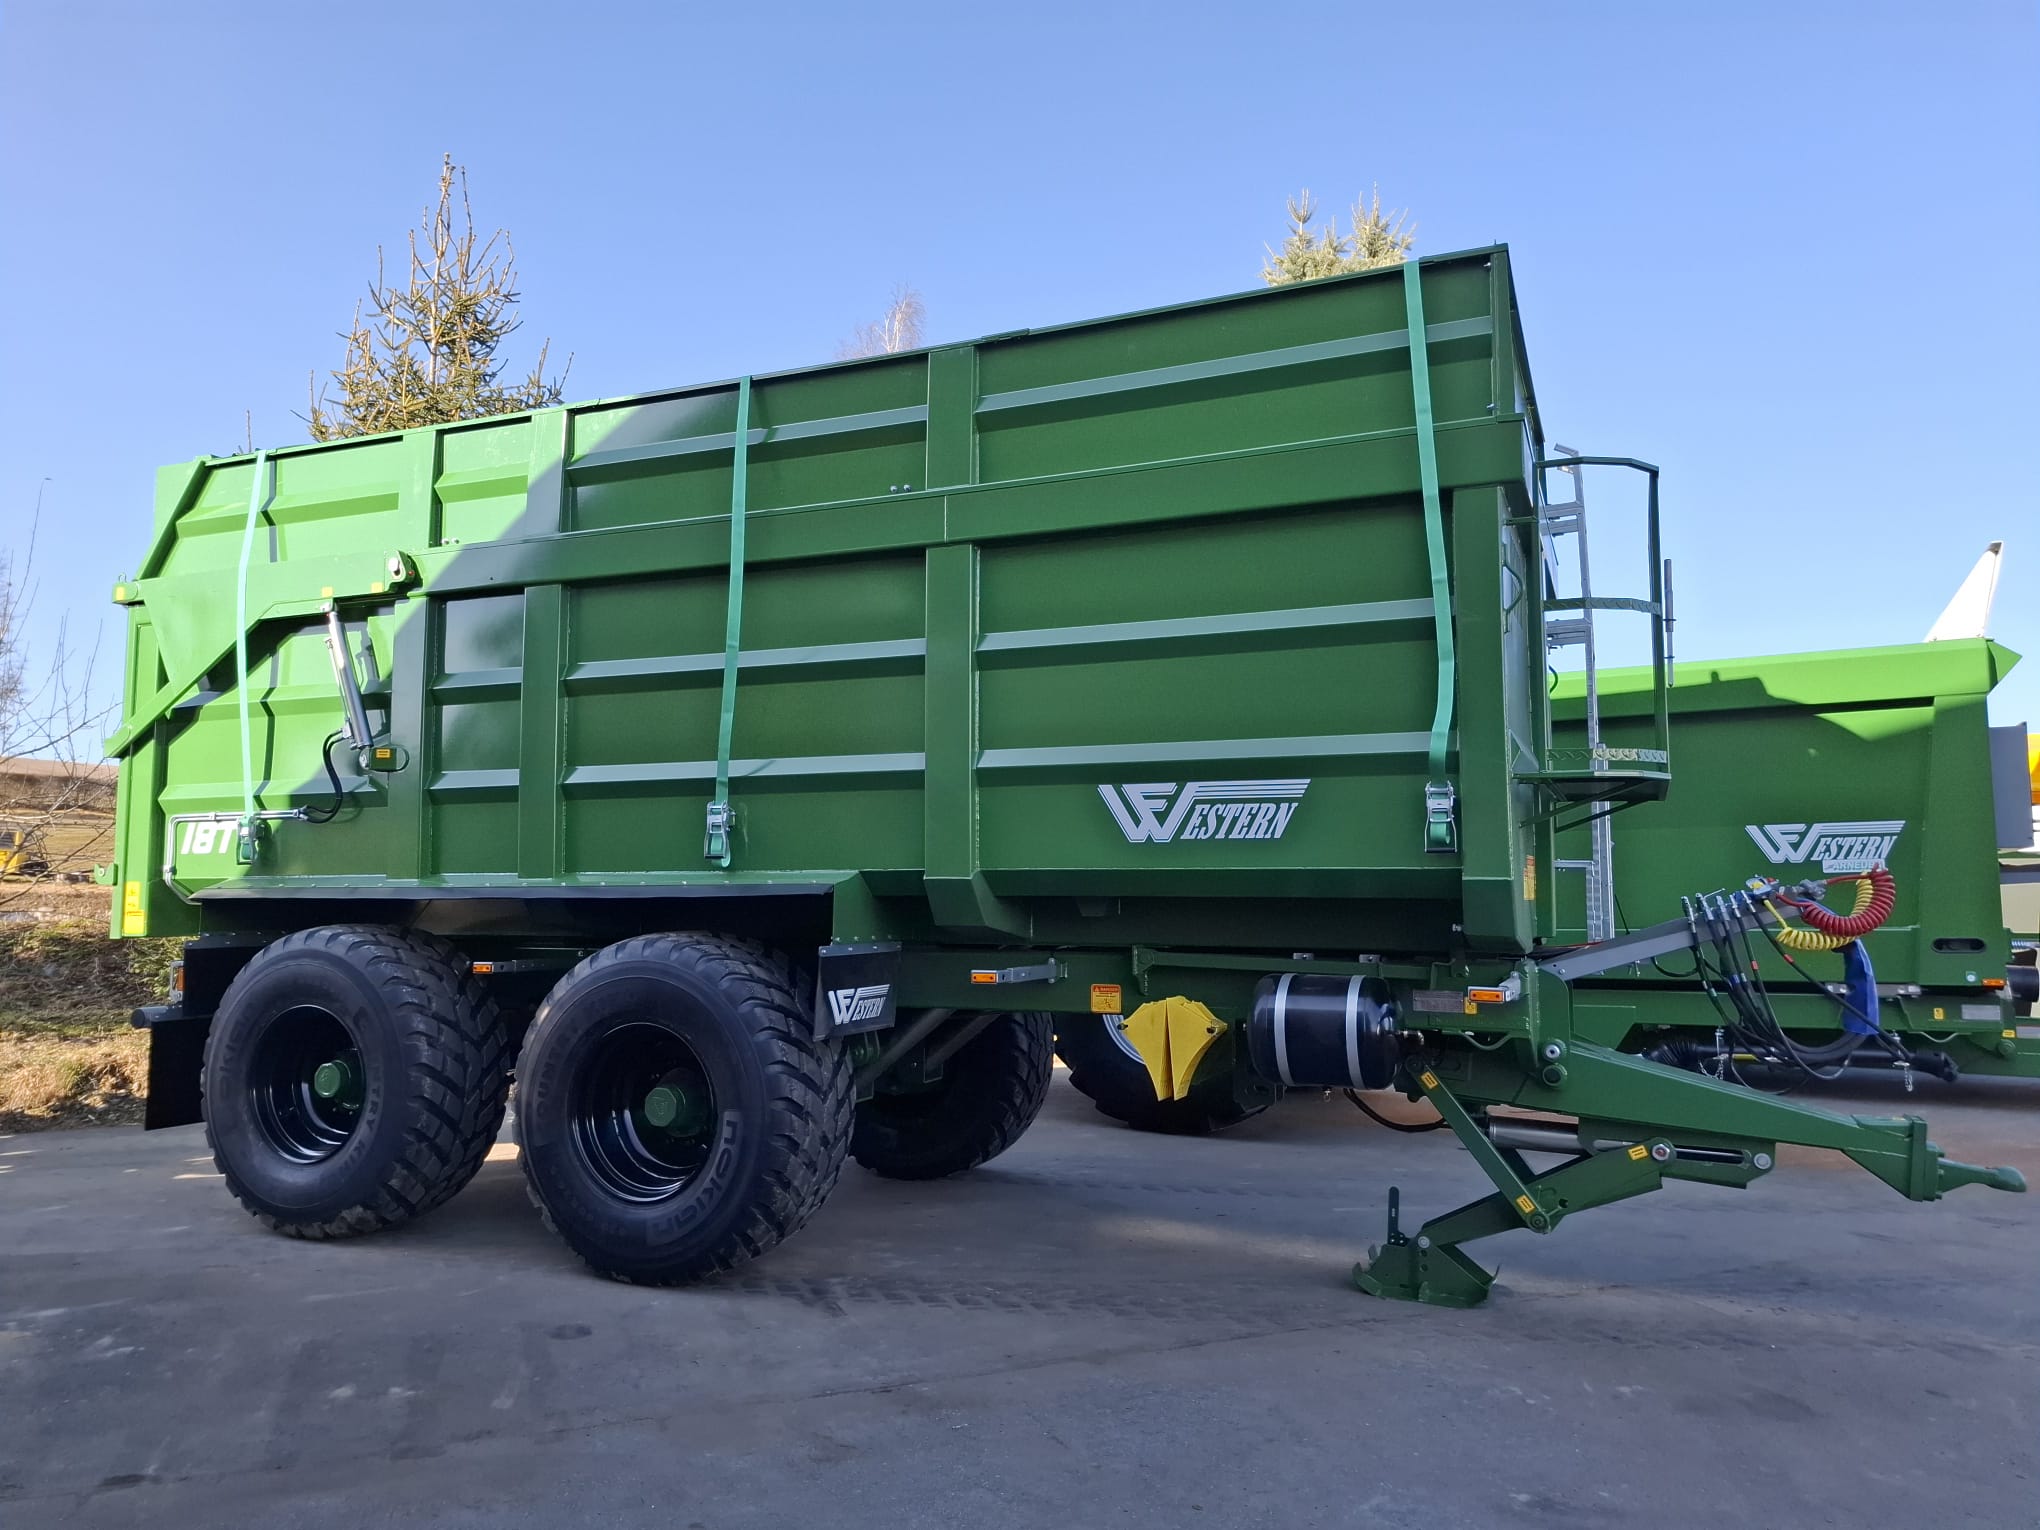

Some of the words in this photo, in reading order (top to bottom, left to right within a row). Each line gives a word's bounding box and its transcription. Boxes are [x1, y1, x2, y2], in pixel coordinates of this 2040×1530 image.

[1097, 778, 1312, 843] WESTERN
[180, 821, 238, 855] 18T
[1744, 820, 1906, 864] WESTERN
